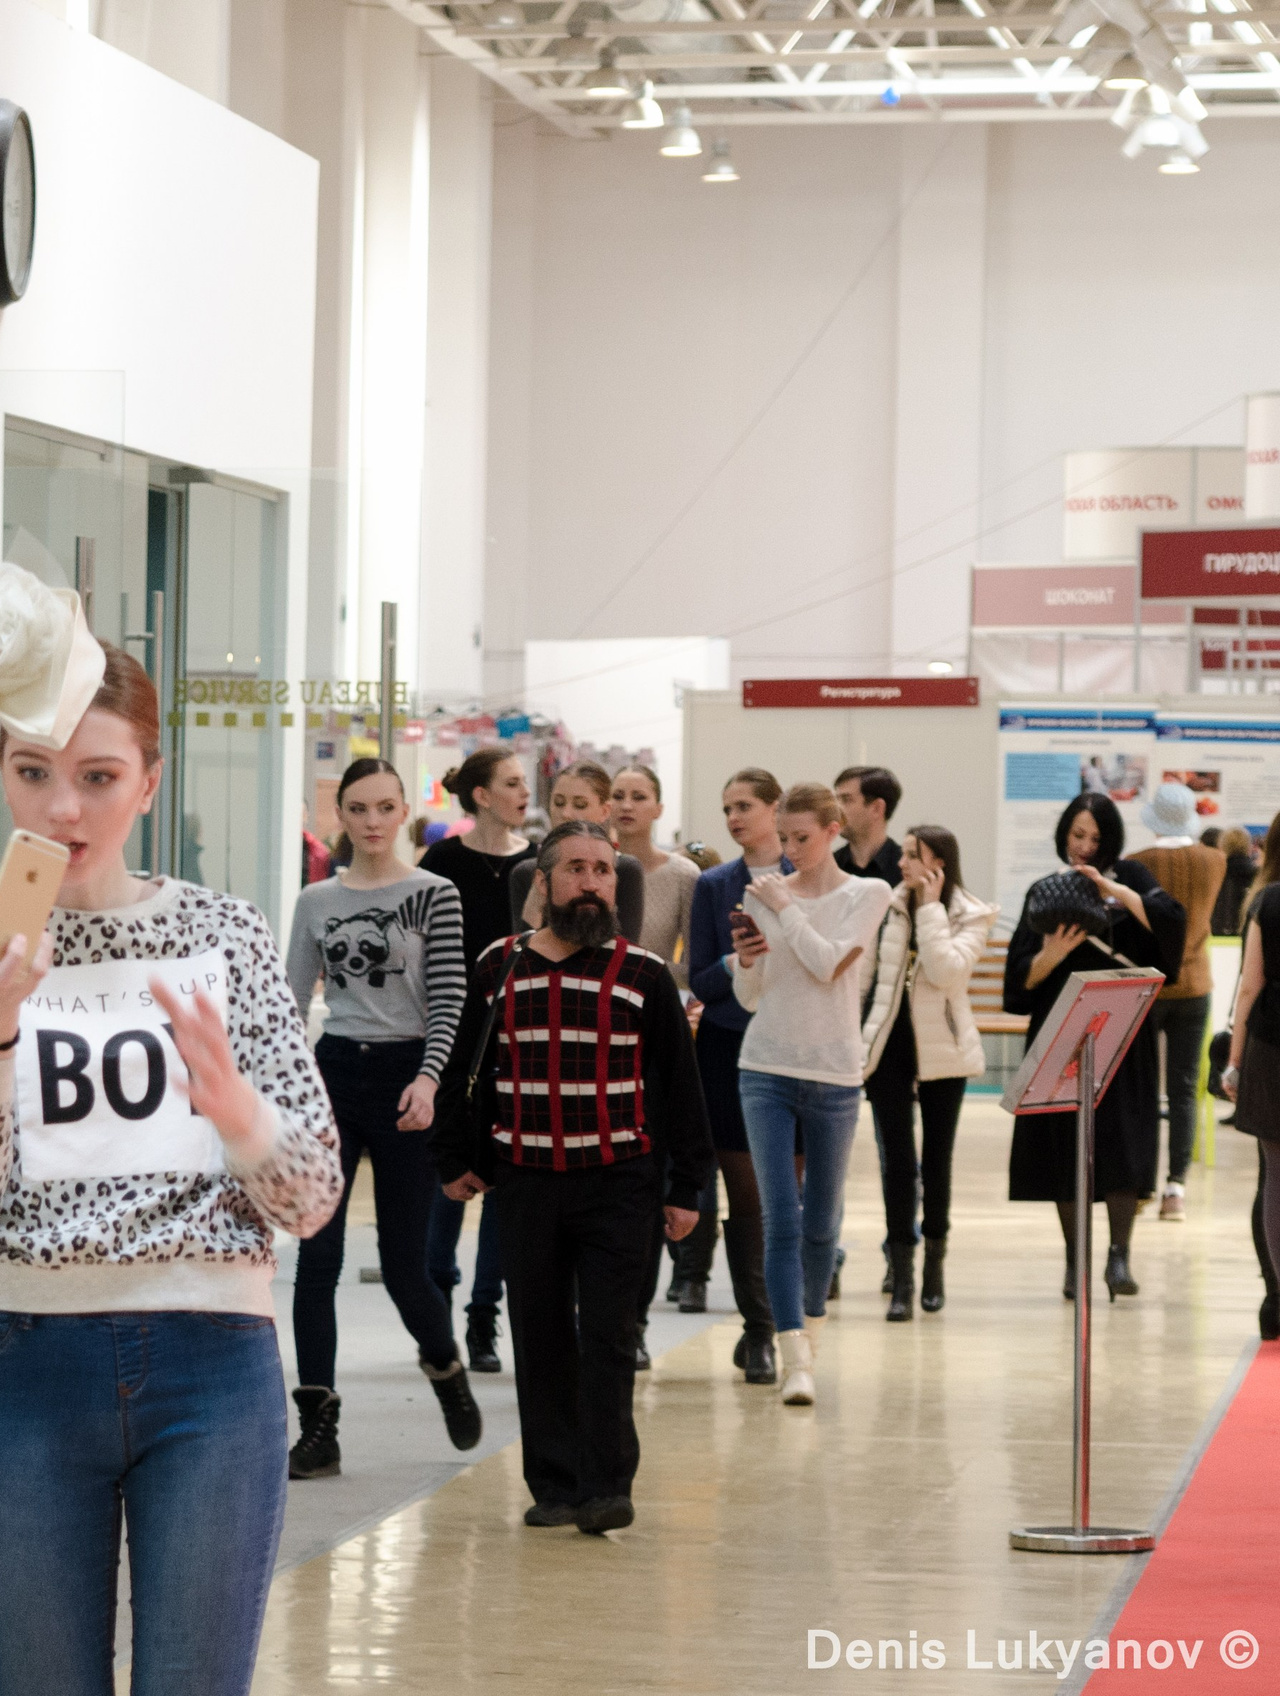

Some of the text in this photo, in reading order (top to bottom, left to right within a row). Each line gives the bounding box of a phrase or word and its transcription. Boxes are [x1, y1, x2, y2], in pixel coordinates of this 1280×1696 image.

[1099, 494, 1178, 511] ОБЛАСТЬ
[25, 972, 218, 1013] WHAT'S UP
[36, 1022, 201, 1126] BO
